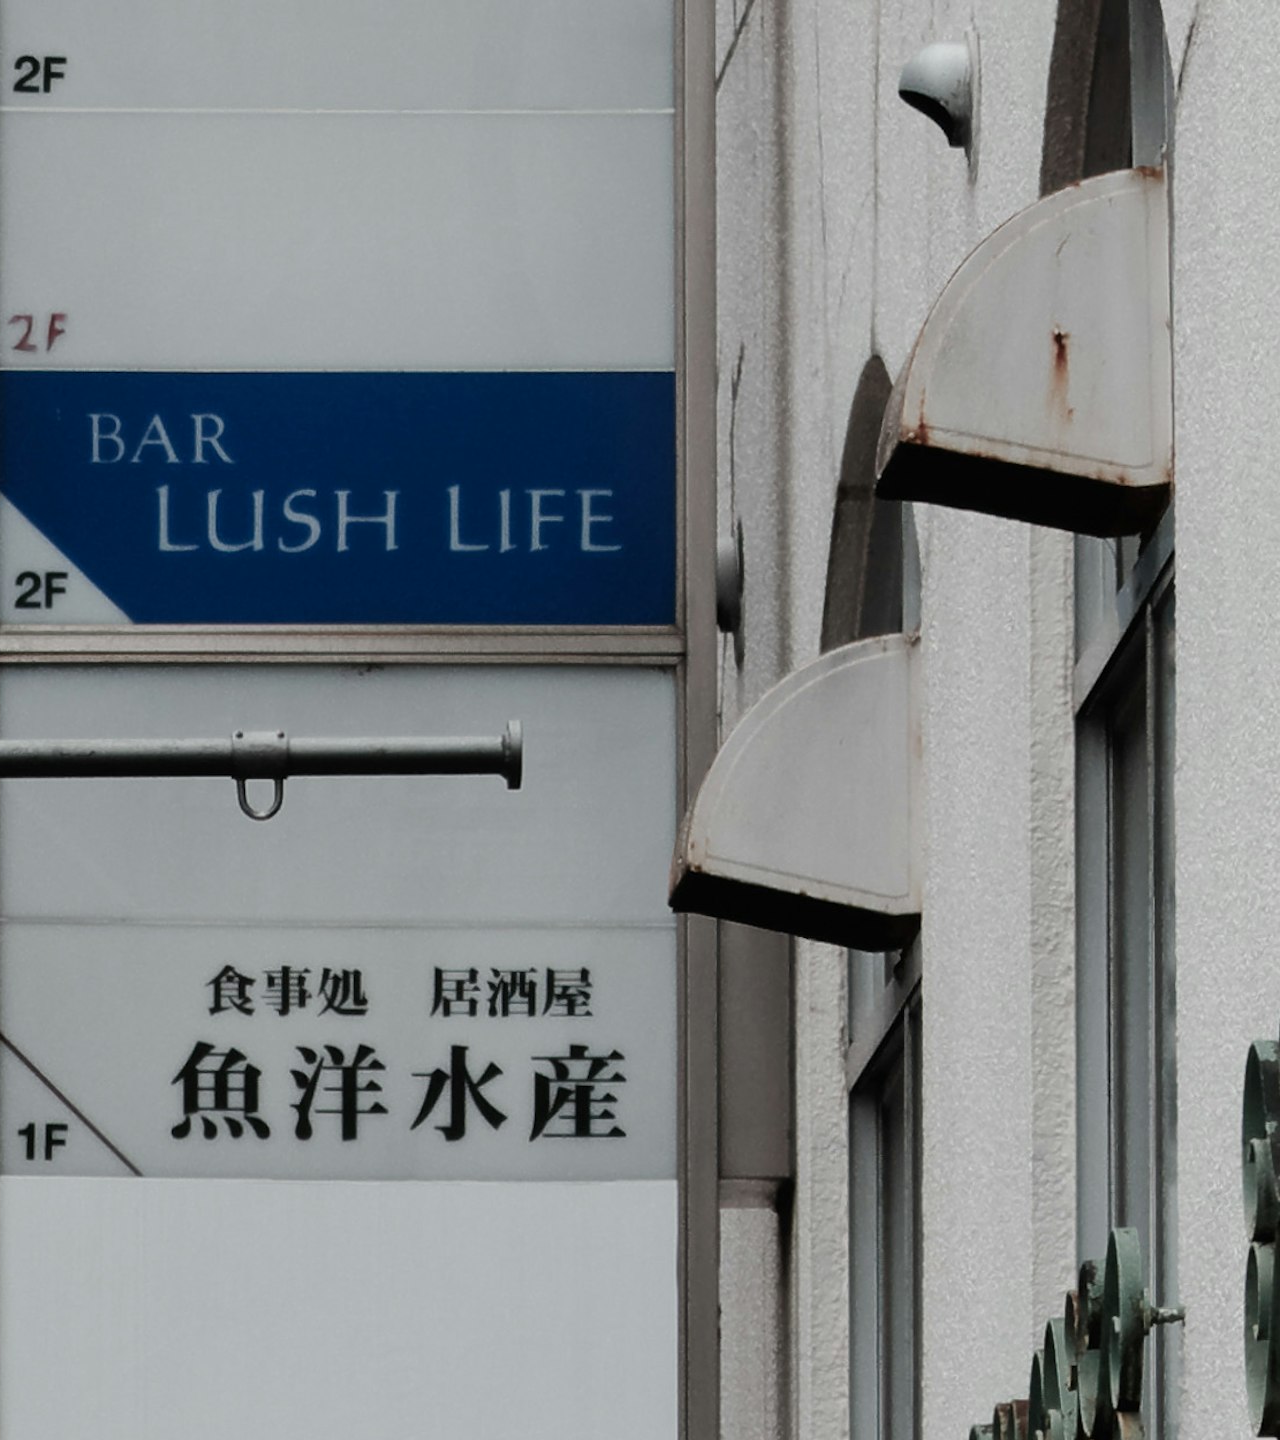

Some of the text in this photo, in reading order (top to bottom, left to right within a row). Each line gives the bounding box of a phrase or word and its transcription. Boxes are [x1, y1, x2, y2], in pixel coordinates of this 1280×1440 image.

[12, 55, 68, 94] 2F
[8, 312, 70, 352] 2F
[88, 411, 236, 466] BAR
[155, 487, 623, 555] LUSH LIFE
[13, 571, 69, 610] 2F
[206, 964, 595, 1018] 食事処 居酒屋
[170, 1040, 628, 1142] 魚洋水産
[17, 1122, 69, 1162] 1F
